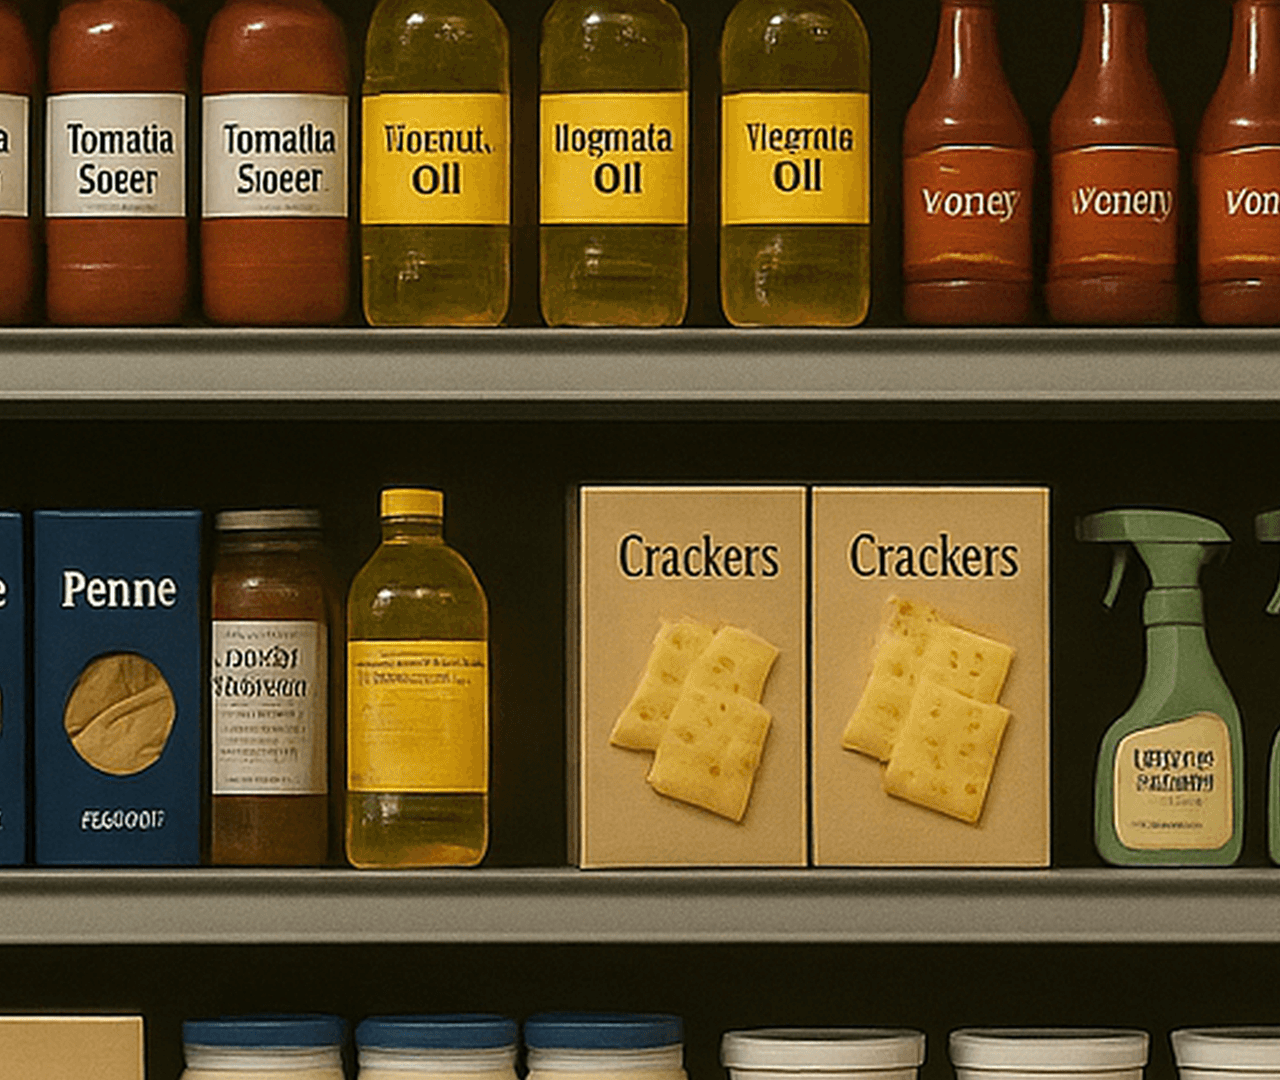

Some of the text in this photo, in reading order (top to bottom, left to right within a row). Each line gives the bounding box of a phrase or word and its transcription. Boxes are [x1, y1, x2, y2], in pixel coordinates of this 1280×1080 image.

[619, 533, 779, 578] Crackers
[850, 533, 1019, 578] Crackers
[62, 571, 177, 609] Penne
